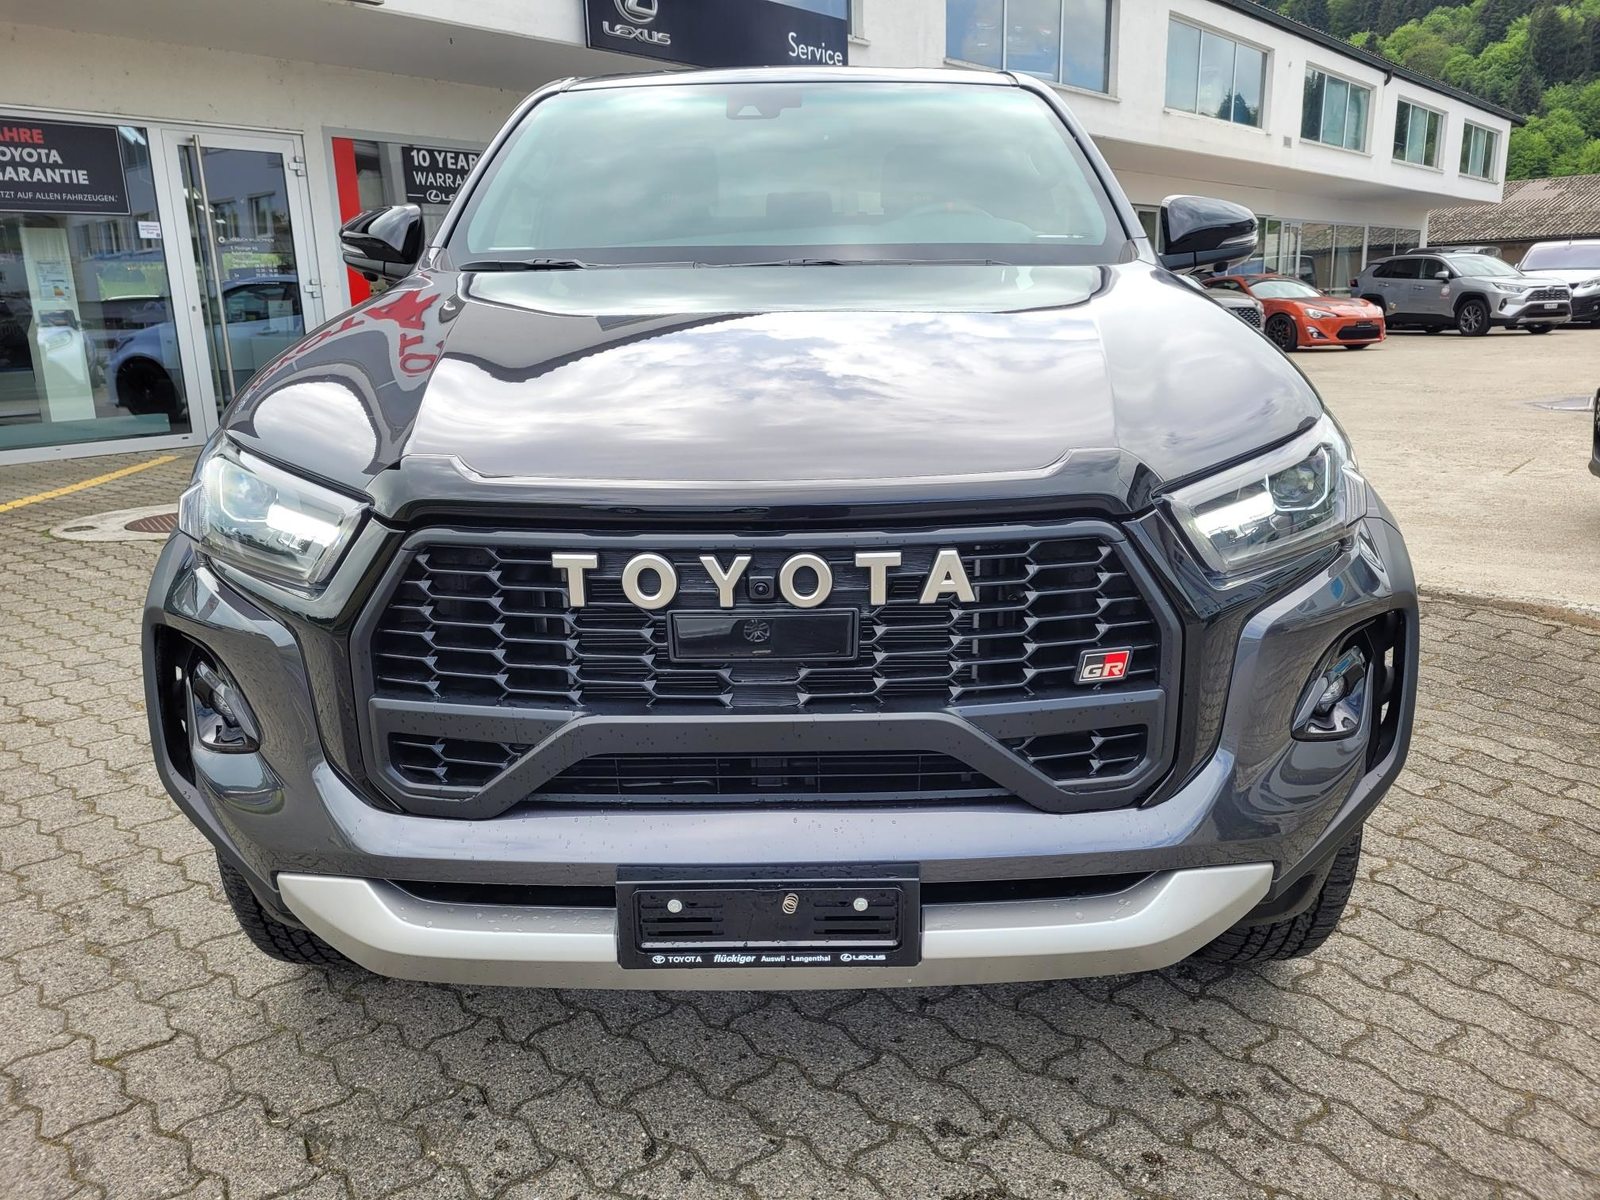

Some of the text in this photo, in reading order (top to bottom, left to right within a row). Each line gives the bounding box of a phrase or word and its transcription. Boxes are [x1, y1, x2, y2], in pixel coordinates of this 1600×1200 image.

[602, 20, 672, 46] LEXUS
[788, 31, 843, 66] Service
[410, 149, 431, 167] 10
[0, 166, 89, 184] ARANTIE
[412, 170, 468, 188] WARRA
[17, 191, 33, 200] AUF
[36, 192, 61, 201] ALLEN
[551, 548, 977, 610] TOYOTA
[1082, 662, 1124, 679] GR
[713, 954, 756, 964] flückiger
[791, 955, 831, 963] Langenthal
